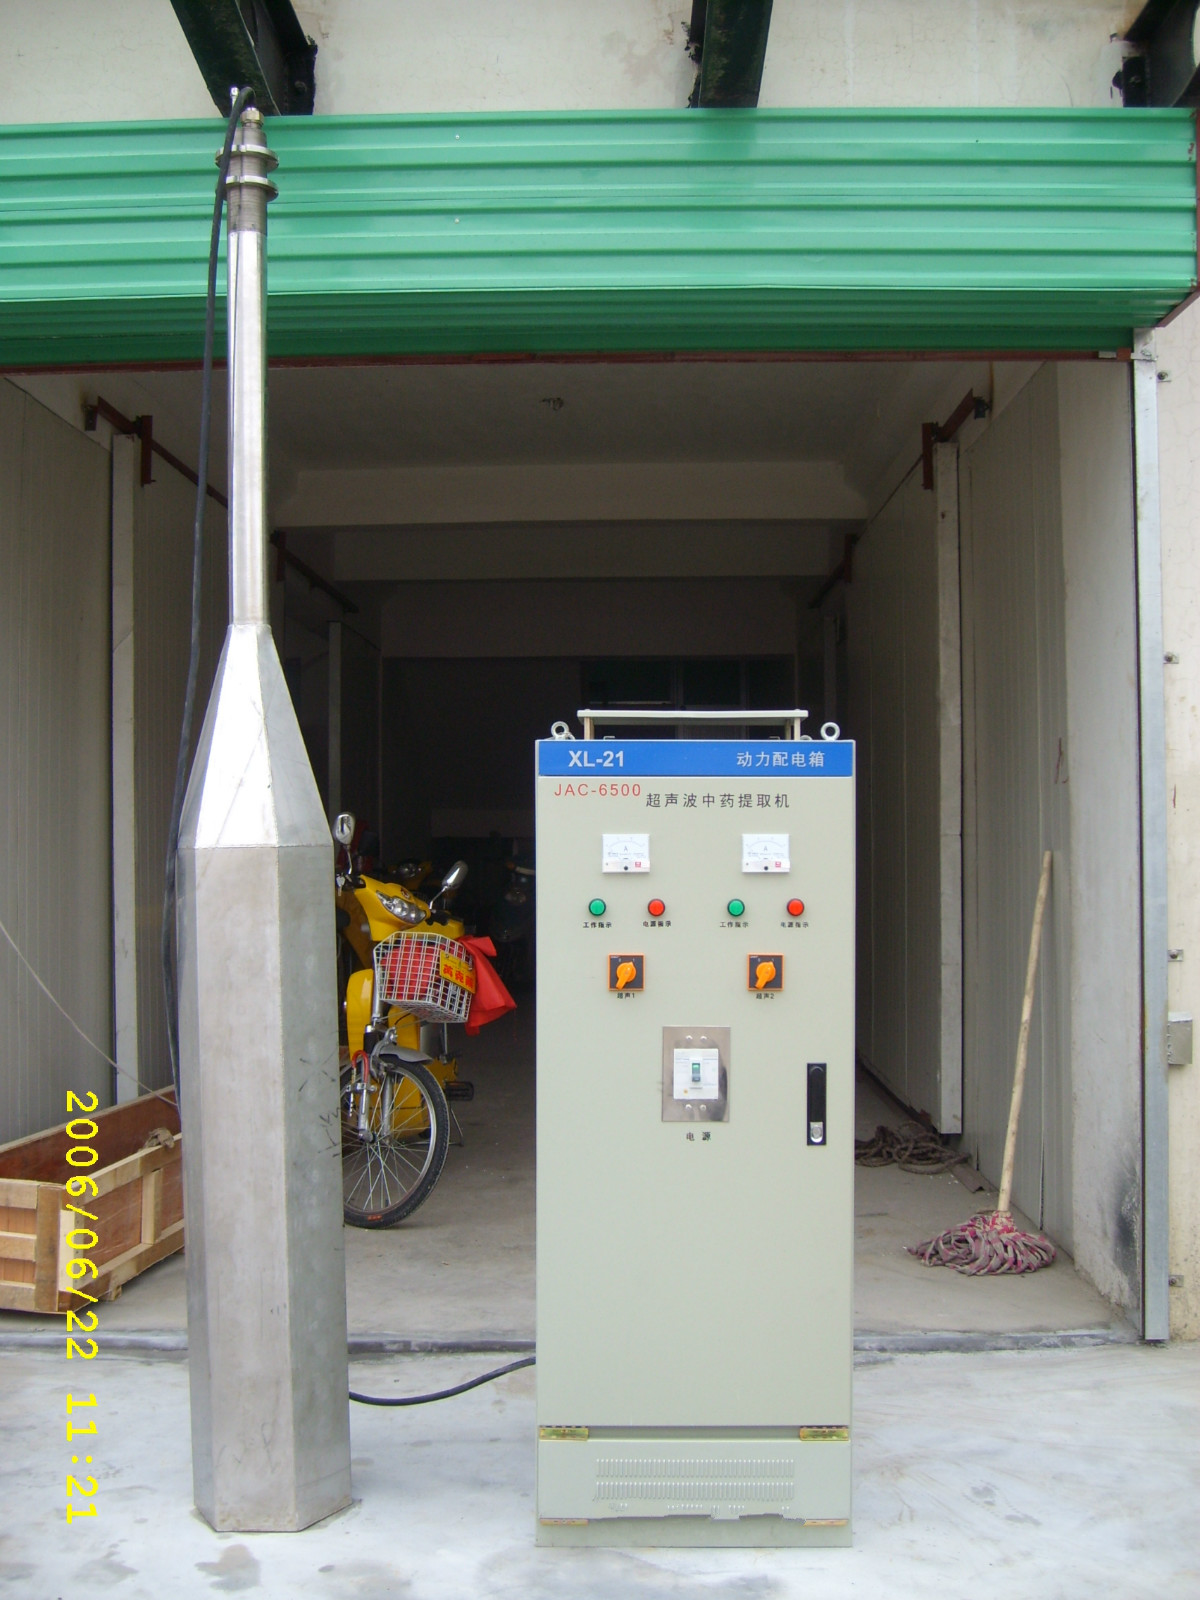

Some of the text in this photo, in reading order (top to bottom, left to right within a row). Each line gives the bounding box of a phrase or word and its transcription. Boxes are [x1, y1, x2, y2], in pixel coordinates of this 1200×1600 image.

[568, 751, 624, 768] XL-21
[736, 751, 825, 768] 动力配电箱
[554, 783, 641, 797] JAC-6500
[645, 792, 790, 809] 超声波中药提取机
[583, 921, 612, 929] 工作指示
[643, 920, 672, 928] 电源指示
[686, 1132, 712, 1142] 电源
